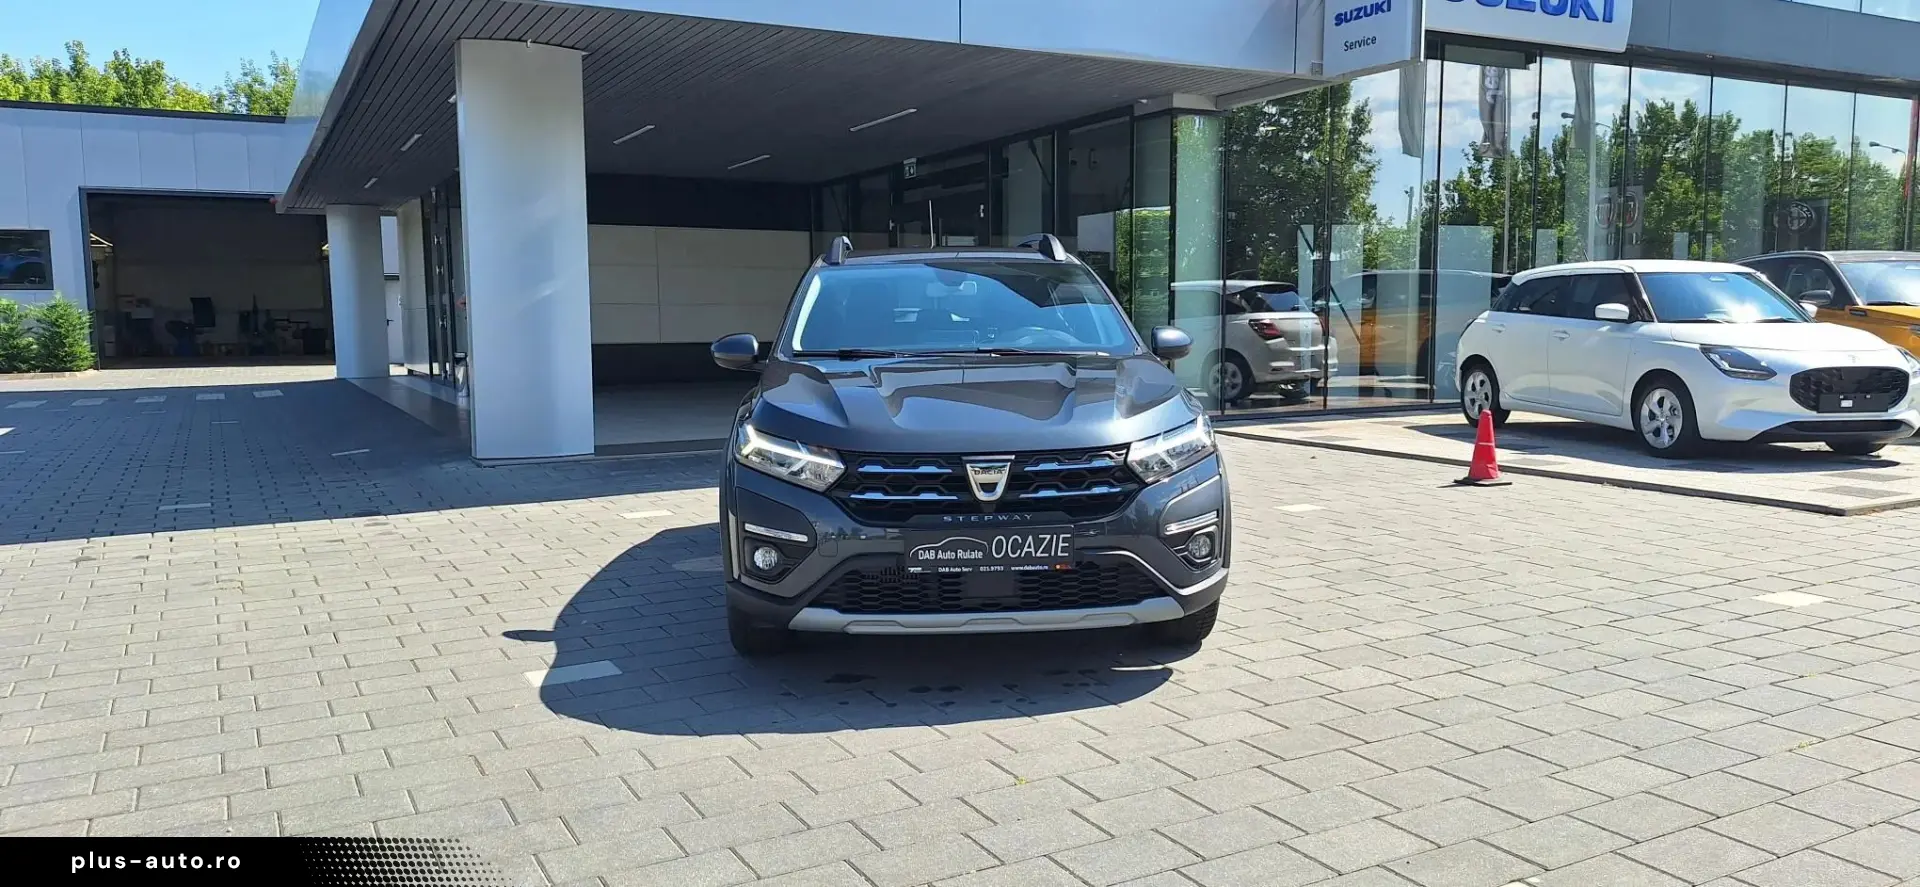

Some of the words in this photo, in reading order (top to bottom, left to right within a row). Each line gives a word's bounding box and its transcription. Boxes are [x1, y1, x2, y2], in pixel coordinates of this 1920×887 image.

[1334, 0, 1392, 27] SUZUKI
[1343, 35, 1377, 52] Service
[943, 514, 1033, 522] STEPWAY
[918, 550, 936, 560] DAB
[937, 550, 956, 560] Auto
[957, 549, 983, 559] Rulate
[991, 534, 1072, 558] OCAZIE
